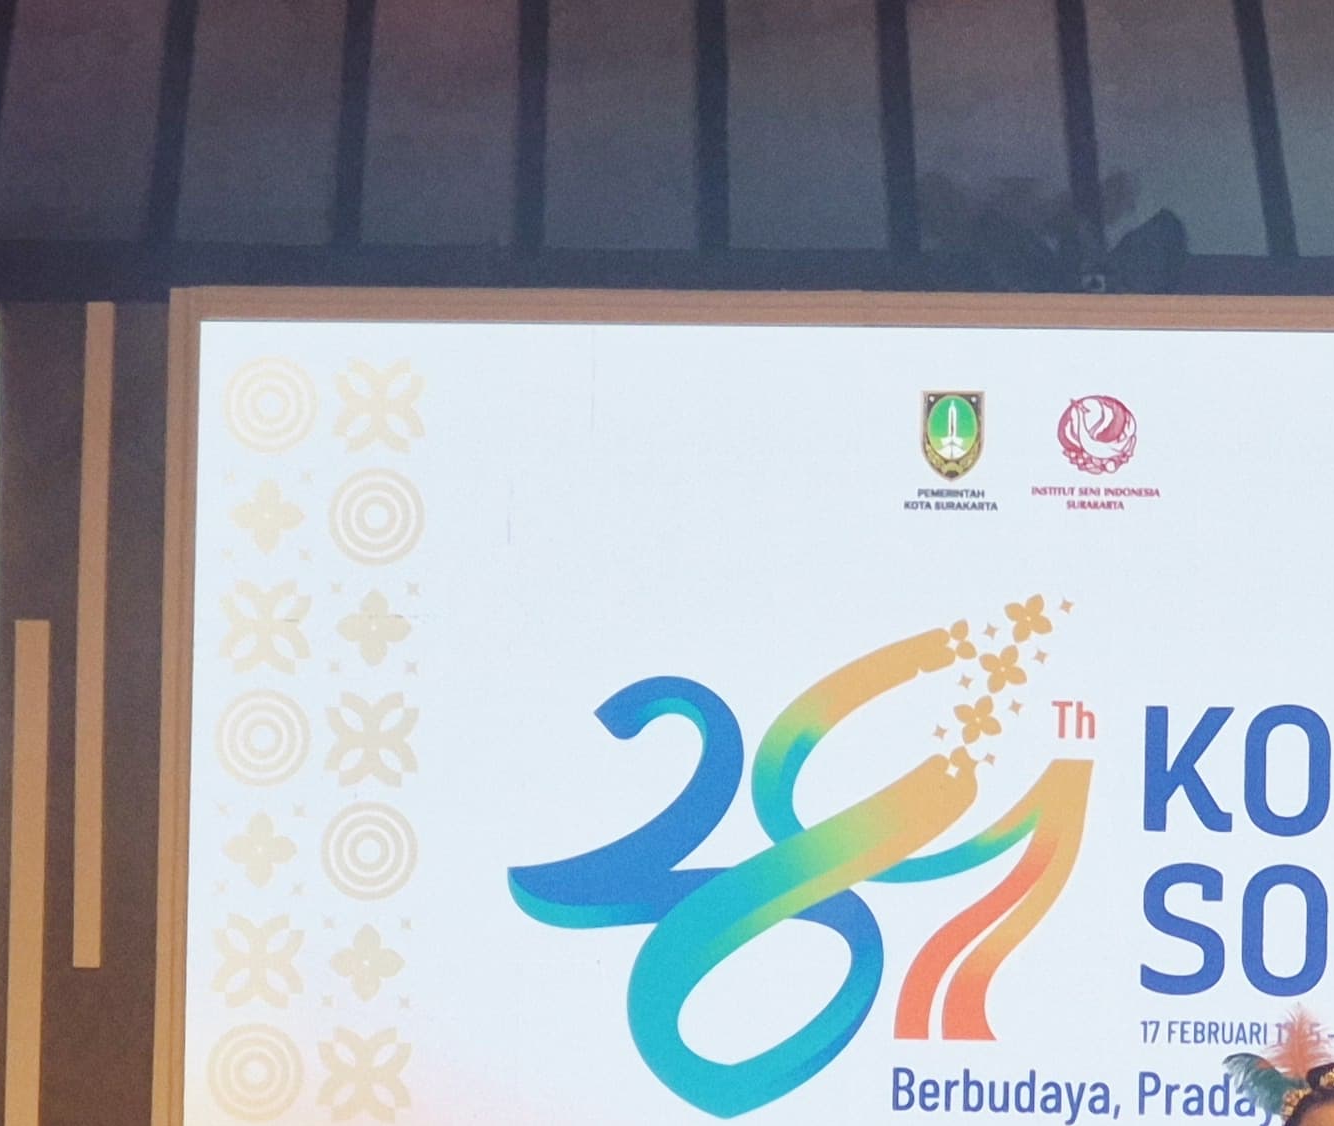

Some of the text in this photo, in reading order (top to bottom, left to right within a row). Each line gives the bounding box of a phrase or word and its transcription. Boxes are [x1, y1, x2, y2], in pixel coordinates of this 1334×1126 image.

[917, 488, 986, 499] PEMERINTAH
[1031, 486, 1160, 498] INSTITUT SENI INDONESIA
[903, 500, 998, 512] KOTA SURAKARTA
[1066, 500, 1125, 510] SURAKARTA
[1051, 700, 1096, 740] Th
[1140, 1020, 1160, 1044] 17
[1167, 1020, 1268, 1046] FEBRUARI
[891, 1066, 1121, 1126] Berbudaya,
